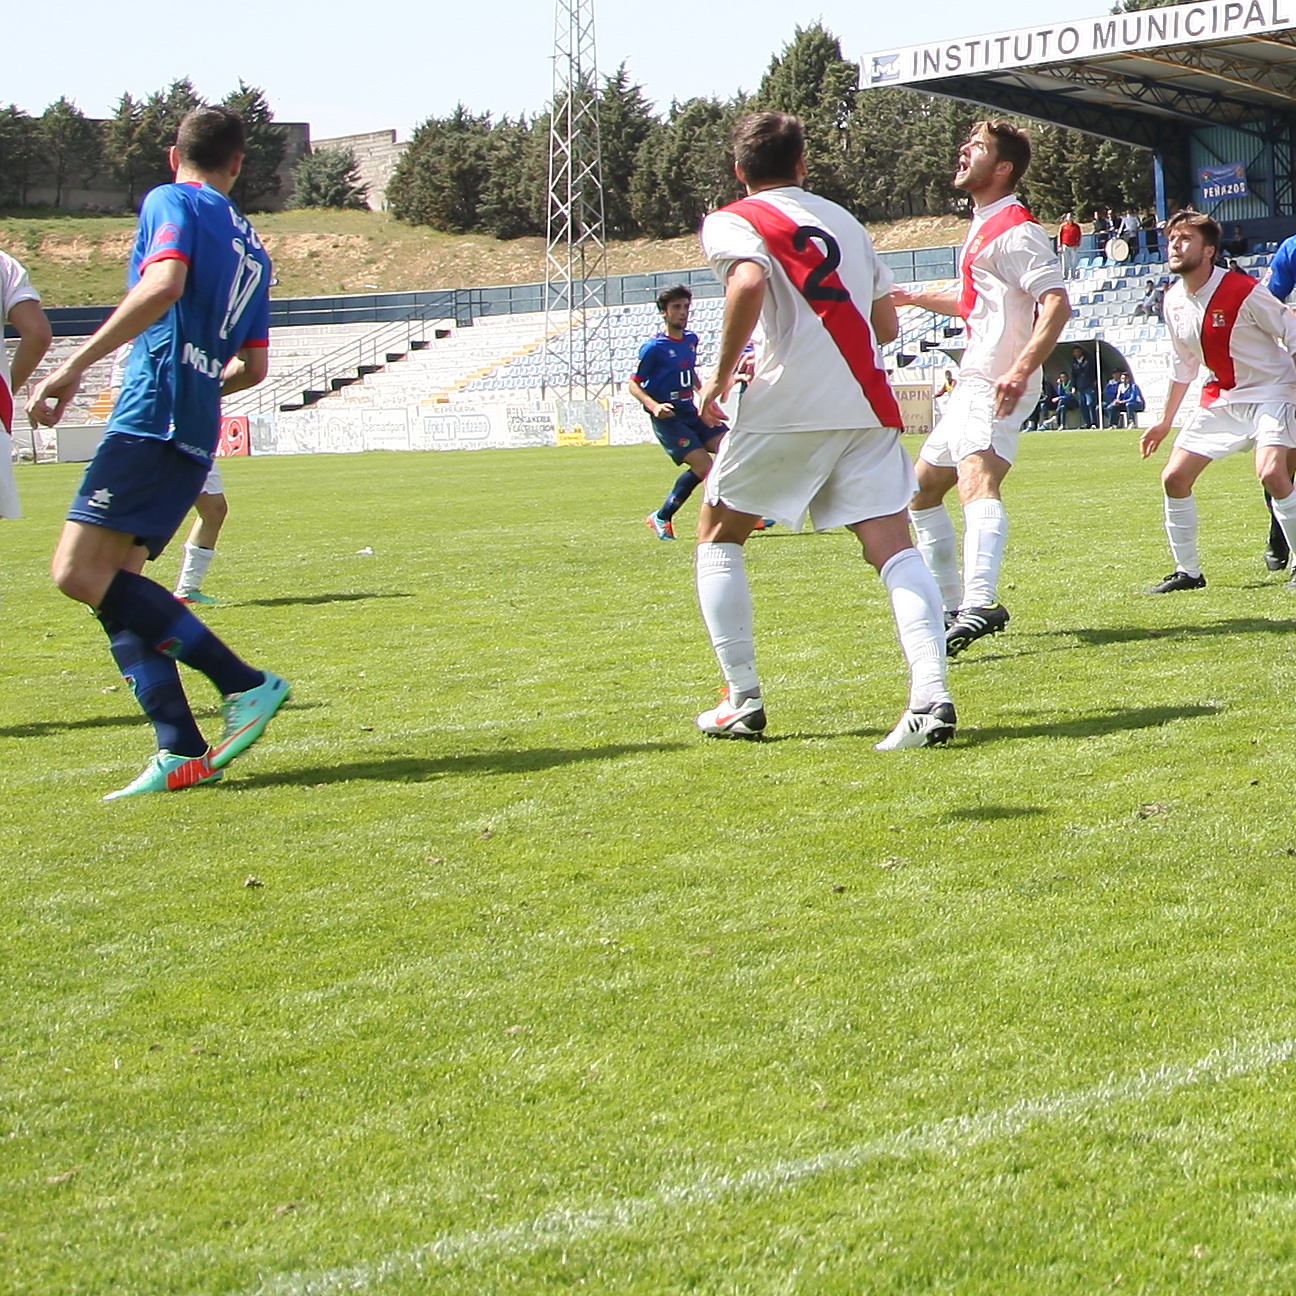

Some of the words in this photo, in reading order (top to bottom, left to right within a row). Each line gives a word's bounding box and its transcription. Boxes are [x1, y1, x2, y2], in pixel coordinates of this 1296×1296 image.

[912, 27, 1080, 77] INSTITUTO
[219, 237, 263, 340] 17
[793, 226, 850, 303] 2
